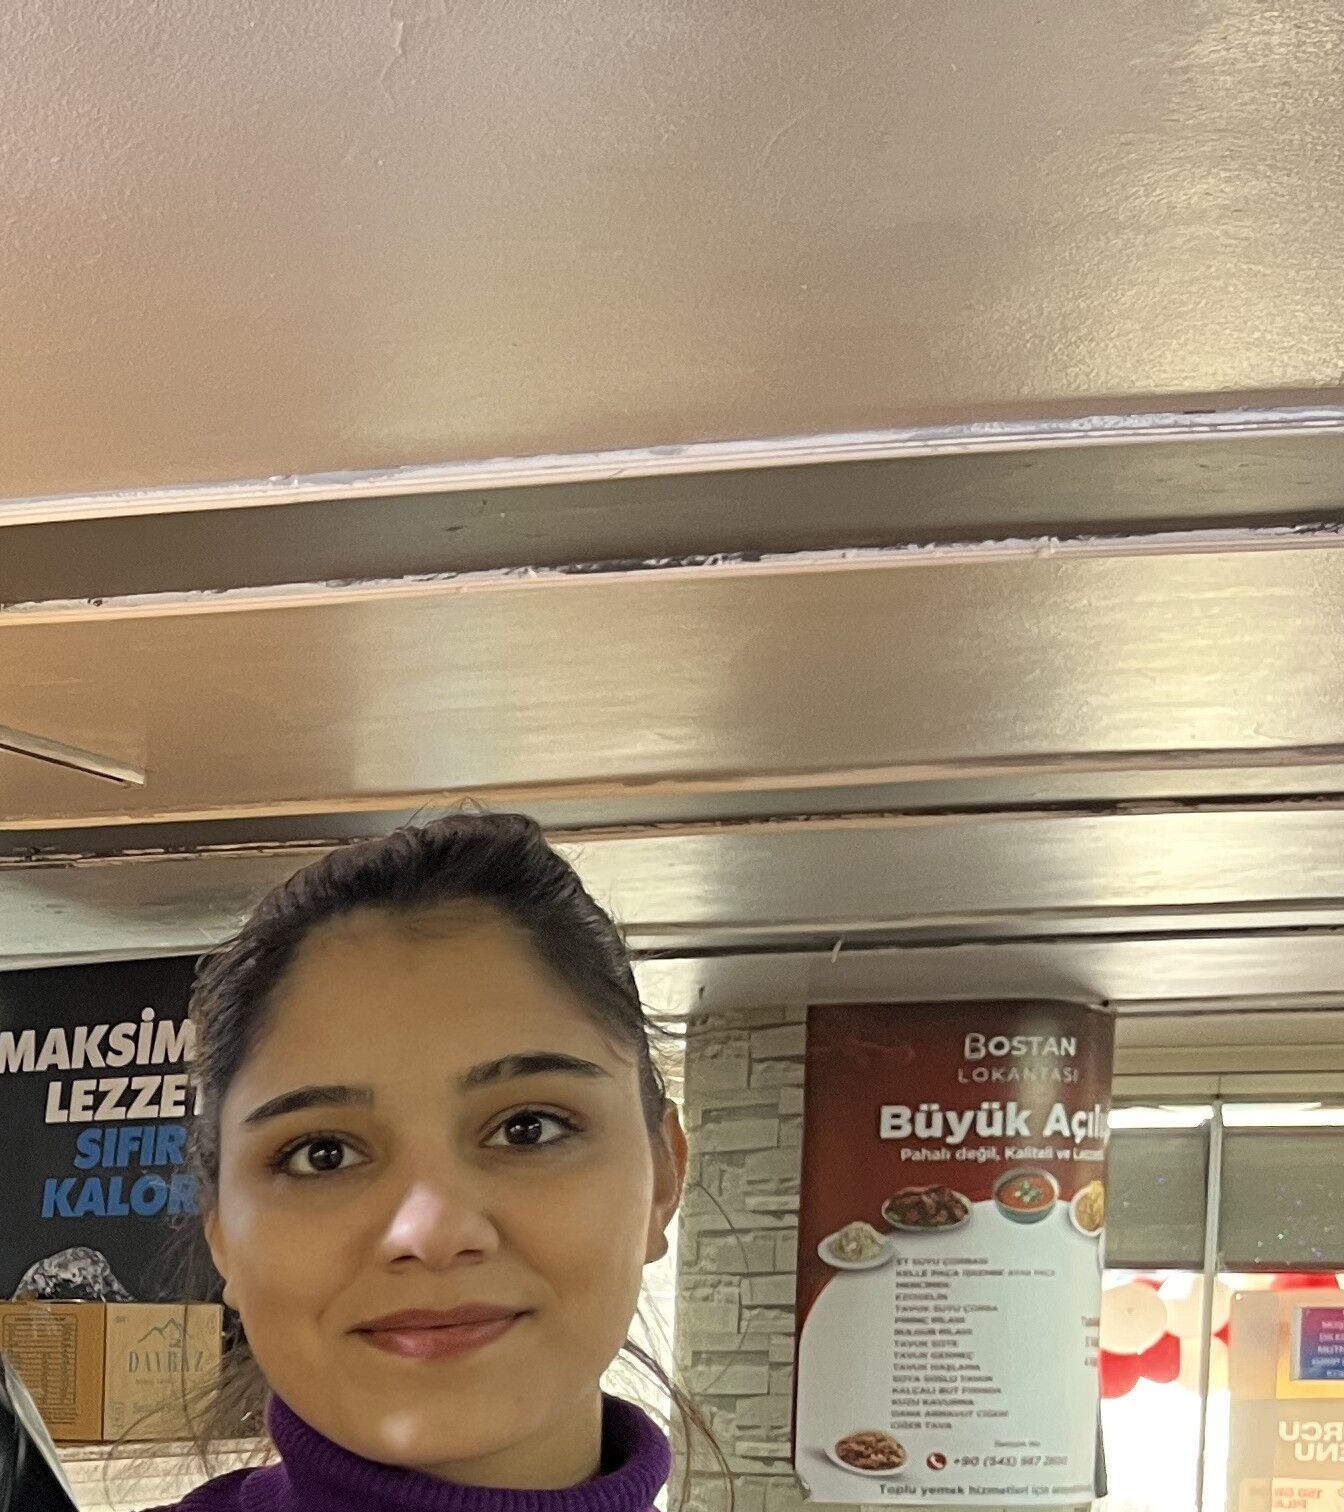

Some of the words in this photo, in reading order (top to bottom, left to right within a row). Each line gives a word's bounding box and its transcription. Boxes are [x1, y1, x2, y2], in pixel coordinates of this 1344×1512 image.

[963, 1032, 1078, 1061] BOSTAN
[957, 1066, 1079, 1084] LOKANTASI
[879, 1101, 1032, 1145] Büyük
[73, 1123, 188, 1170] SIFIR
[879, 1484, 916, 1497] Toplu
